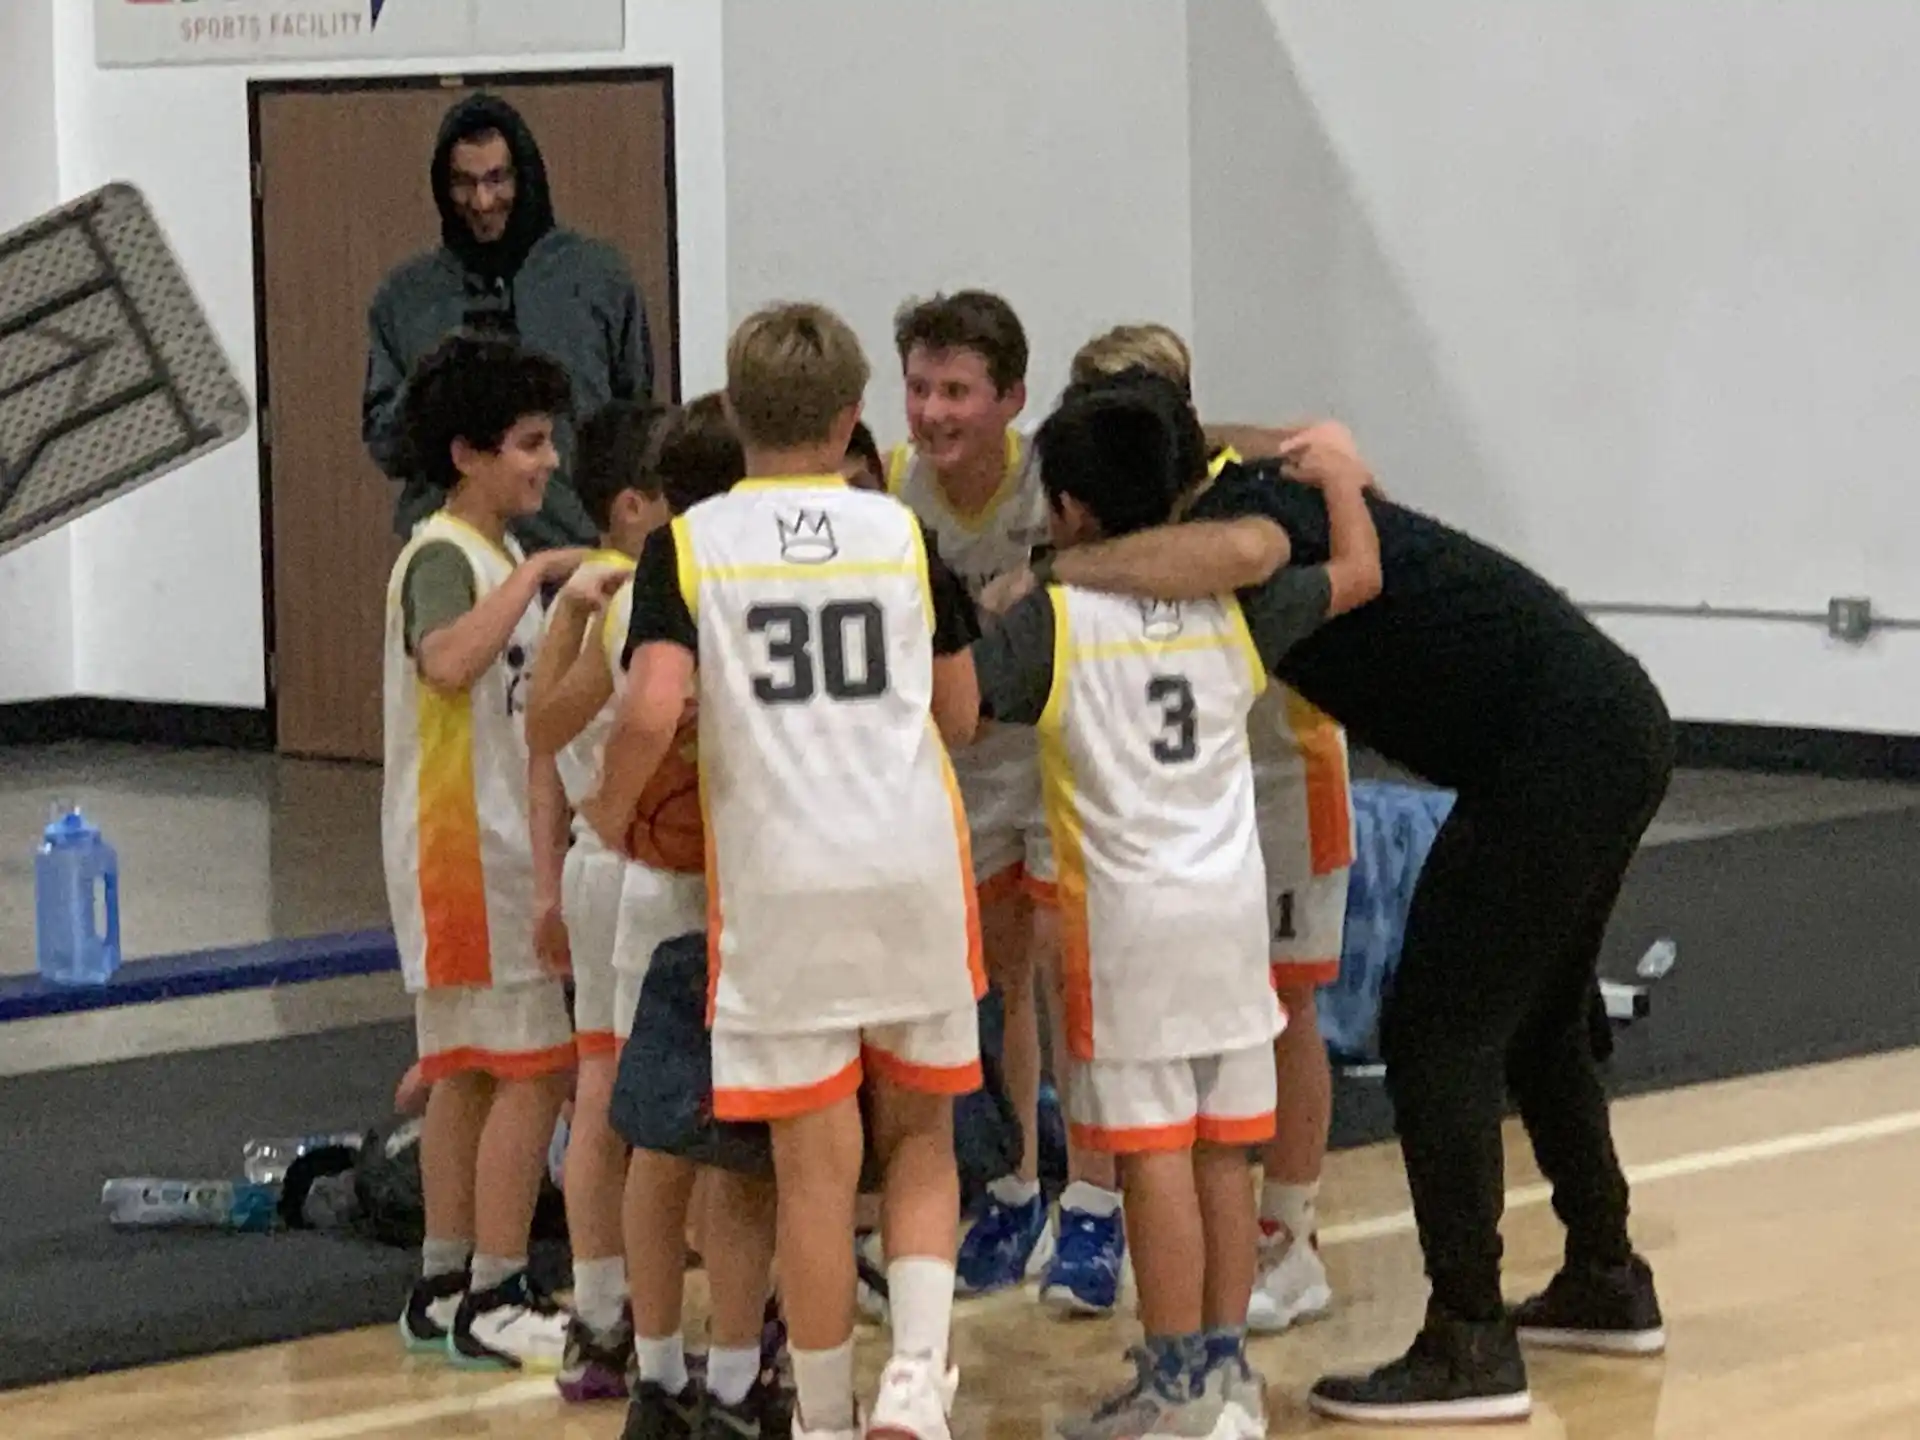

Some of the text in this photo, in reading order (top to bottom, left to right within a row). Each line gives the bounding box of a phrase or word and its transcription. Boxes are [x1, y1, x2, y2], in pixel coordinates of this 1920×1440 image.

[181, 12, 362, 43] SPORTS FACILITY
[746, 600, 888, 702] 30
[1147, 675, 1199, 764] 3
